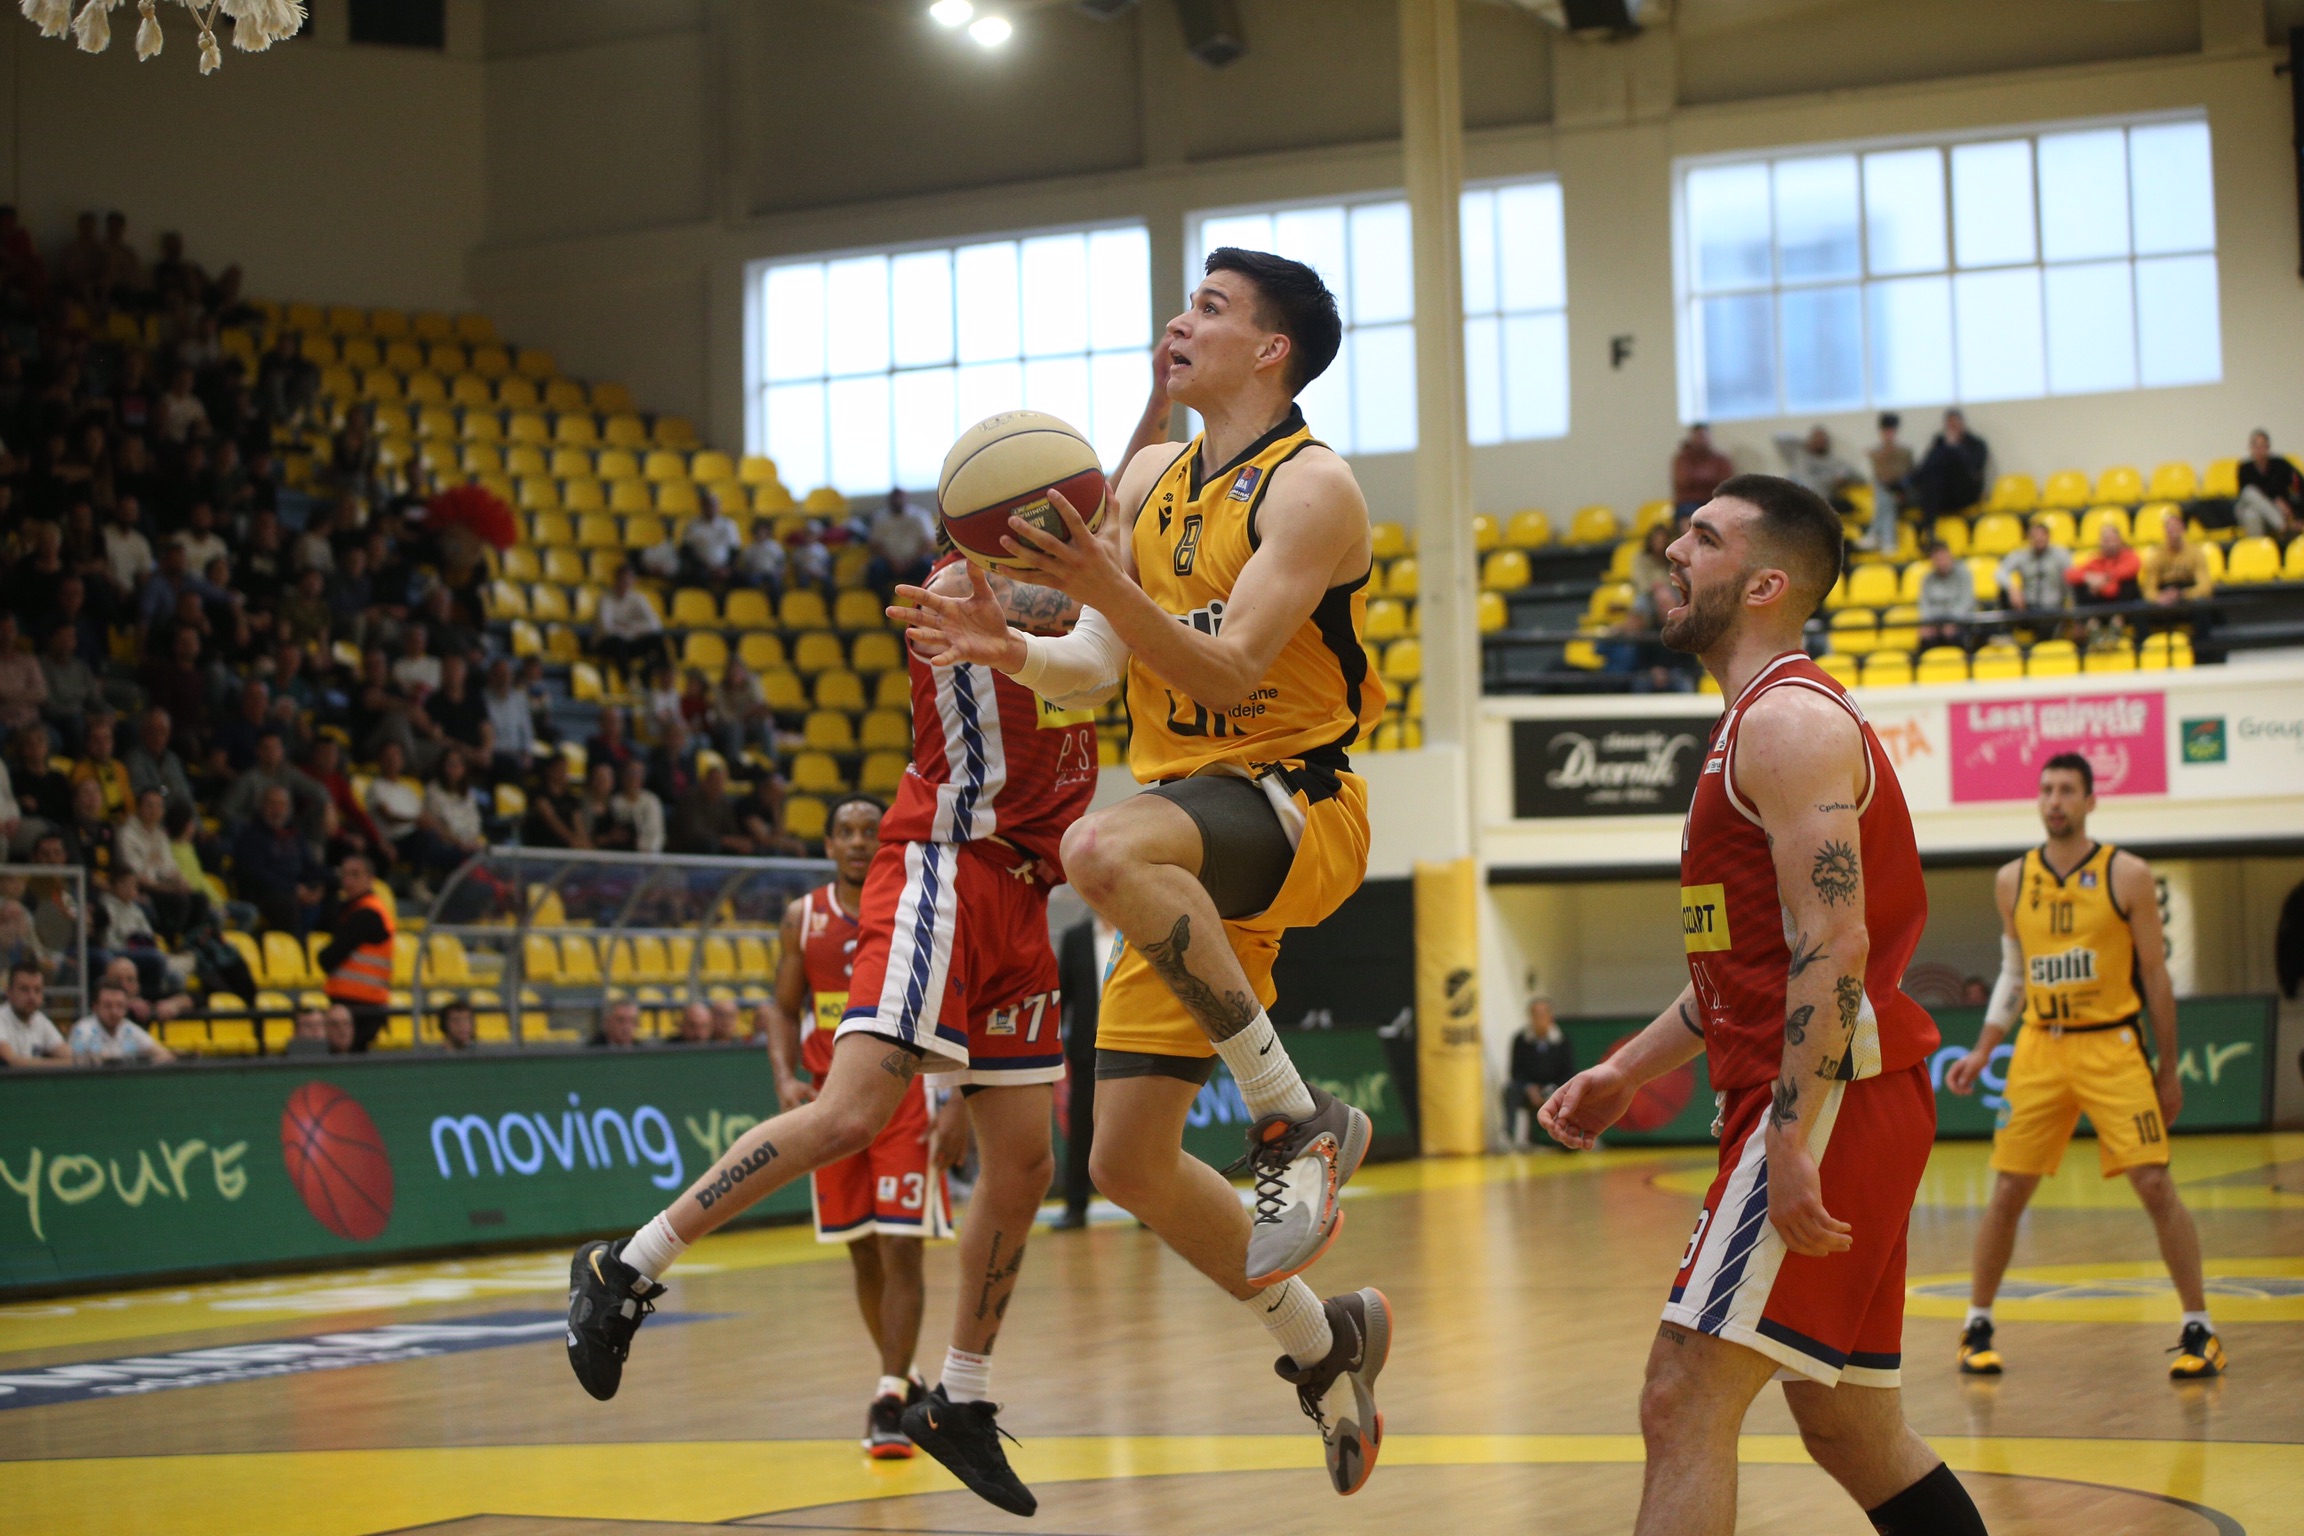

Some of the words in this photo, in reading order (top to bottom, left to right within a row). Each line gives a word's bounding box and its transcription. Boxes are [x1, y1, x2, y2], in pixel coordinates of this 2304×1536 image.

[1173, 513, 1203, 576] 8
[1248, 687, 1278, 701] ane
[1878, 716, 1933, 768] TA
[2050, 901, 2073, 935] 10
[2030, 948, 2095, 985] split
[430, 1091, 684, 1190] moving
[2132, 1109, 2162, 1146] 10
[901, 1171, 925, 1210] 3
